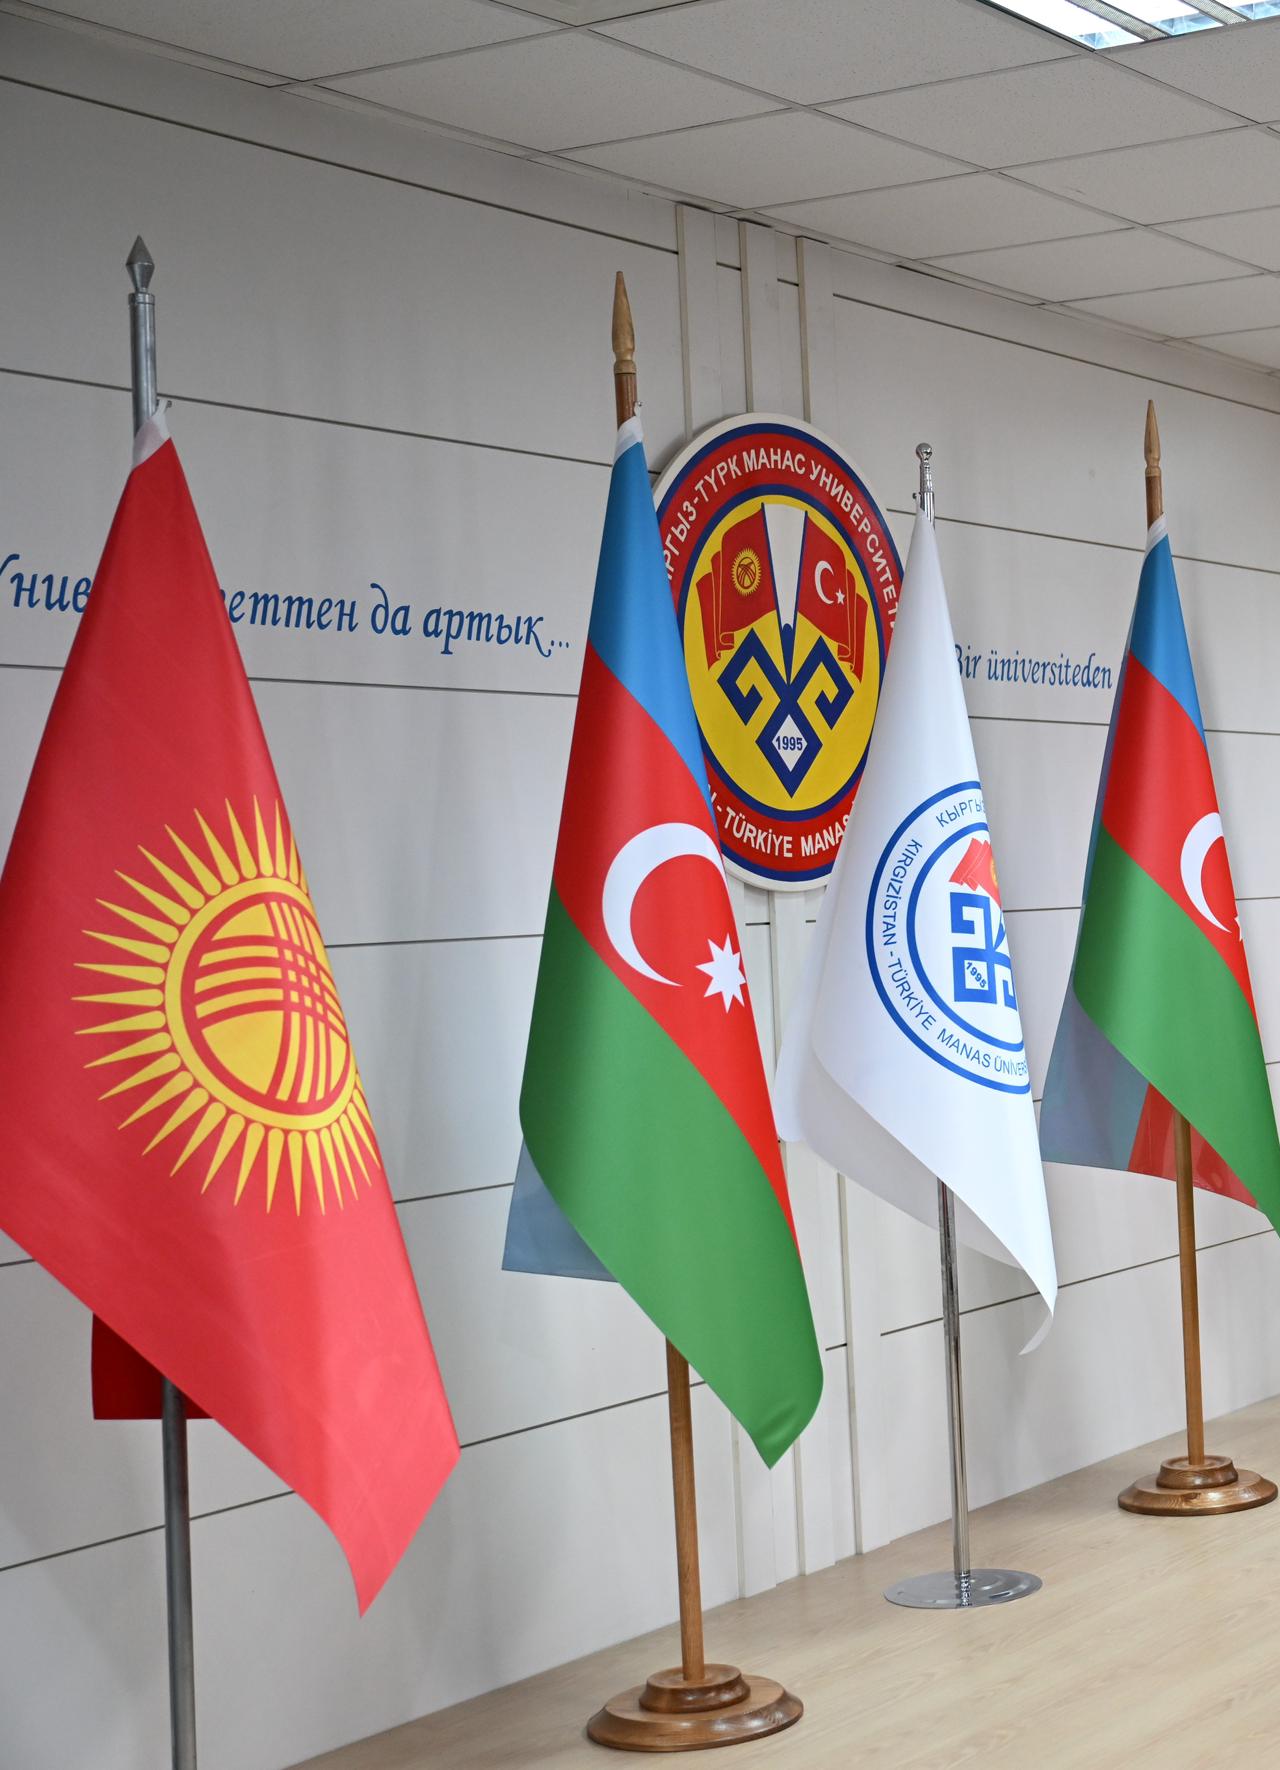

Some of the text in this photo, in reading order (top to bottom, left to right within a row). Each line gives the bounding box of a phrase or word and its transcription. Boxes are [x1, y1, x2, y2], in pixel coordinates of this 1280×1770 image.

[743, 447, 806, 475] МАНАС
[809, 459, 899, 629] УНИВЕРСИТЕТ
[370, 582, 412, 636] да
[954, 644, 1113, 689] Bir üniversiteden
[775, 735, 804, 751] 1995
[882, 838, 923, 946] KIRGIZİSTAN
[937, 1028, 991, 1068] MANAS
[966, 961, 987, 988] 1995
